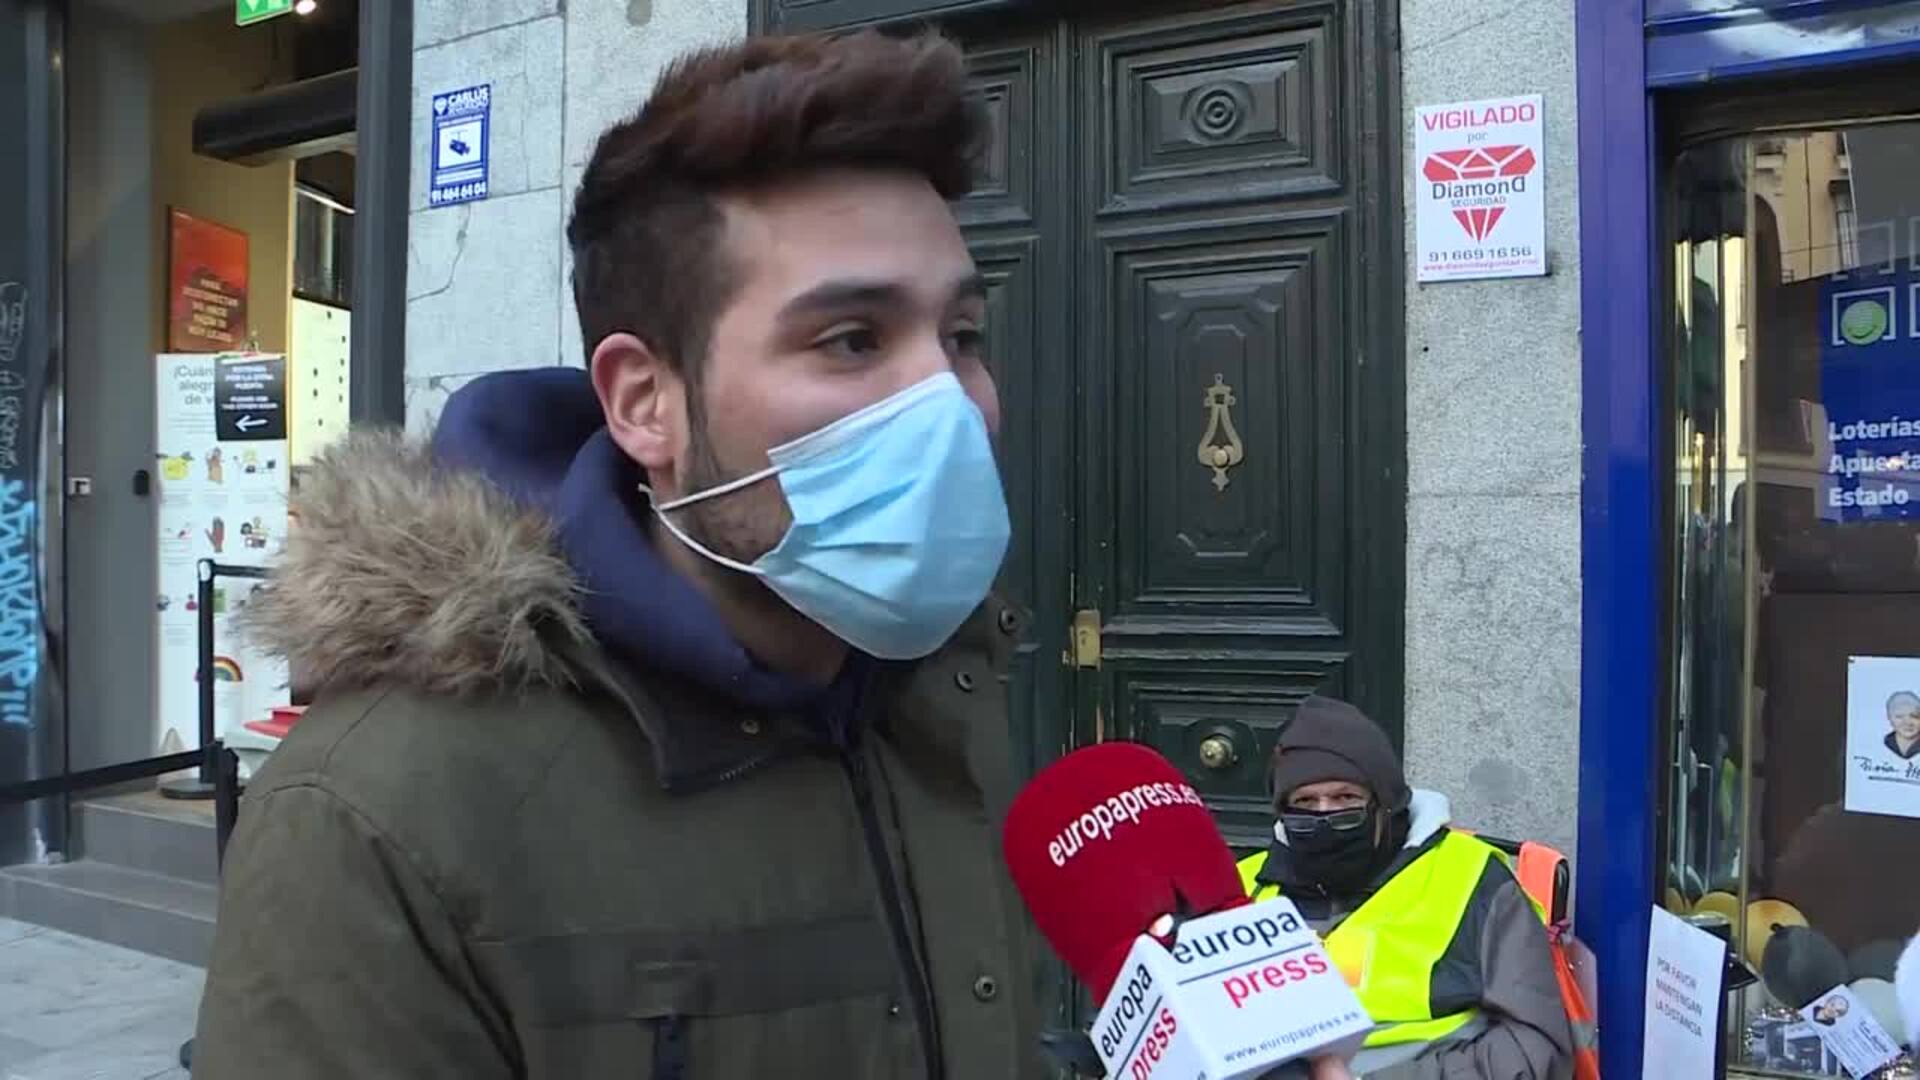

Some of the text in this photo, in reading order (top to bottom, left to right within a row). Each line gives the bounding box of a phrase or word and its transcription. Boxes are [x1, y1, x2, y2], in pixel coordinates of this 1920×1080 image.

[1423, 103, 1535, 131] VIGILADO
[1467, 131, 1488, 144] por
[1450, 196, 1507, 208] SEGURIDAD
[1428, 250, 1448, 262] 91
[1452, 248, 1484, 261] 669
[1488, 247, 1508, 259] 16
[1829, 415, 1920, 440] Loterías
[1828, 451, 1920, 478] Apueta
[1828, 483, 1910, 507] Estado
[1173, 911, 1301, 965] europa
[1222, 952, 1328, 1009] press
[1671, 966, 1697, 990] FAVOR
[1101, 963, 1153, 1059] europa
[1664, 1004, 1703, 1037] DISTANCIA
[1131, 1008, 1177, 1080] press
